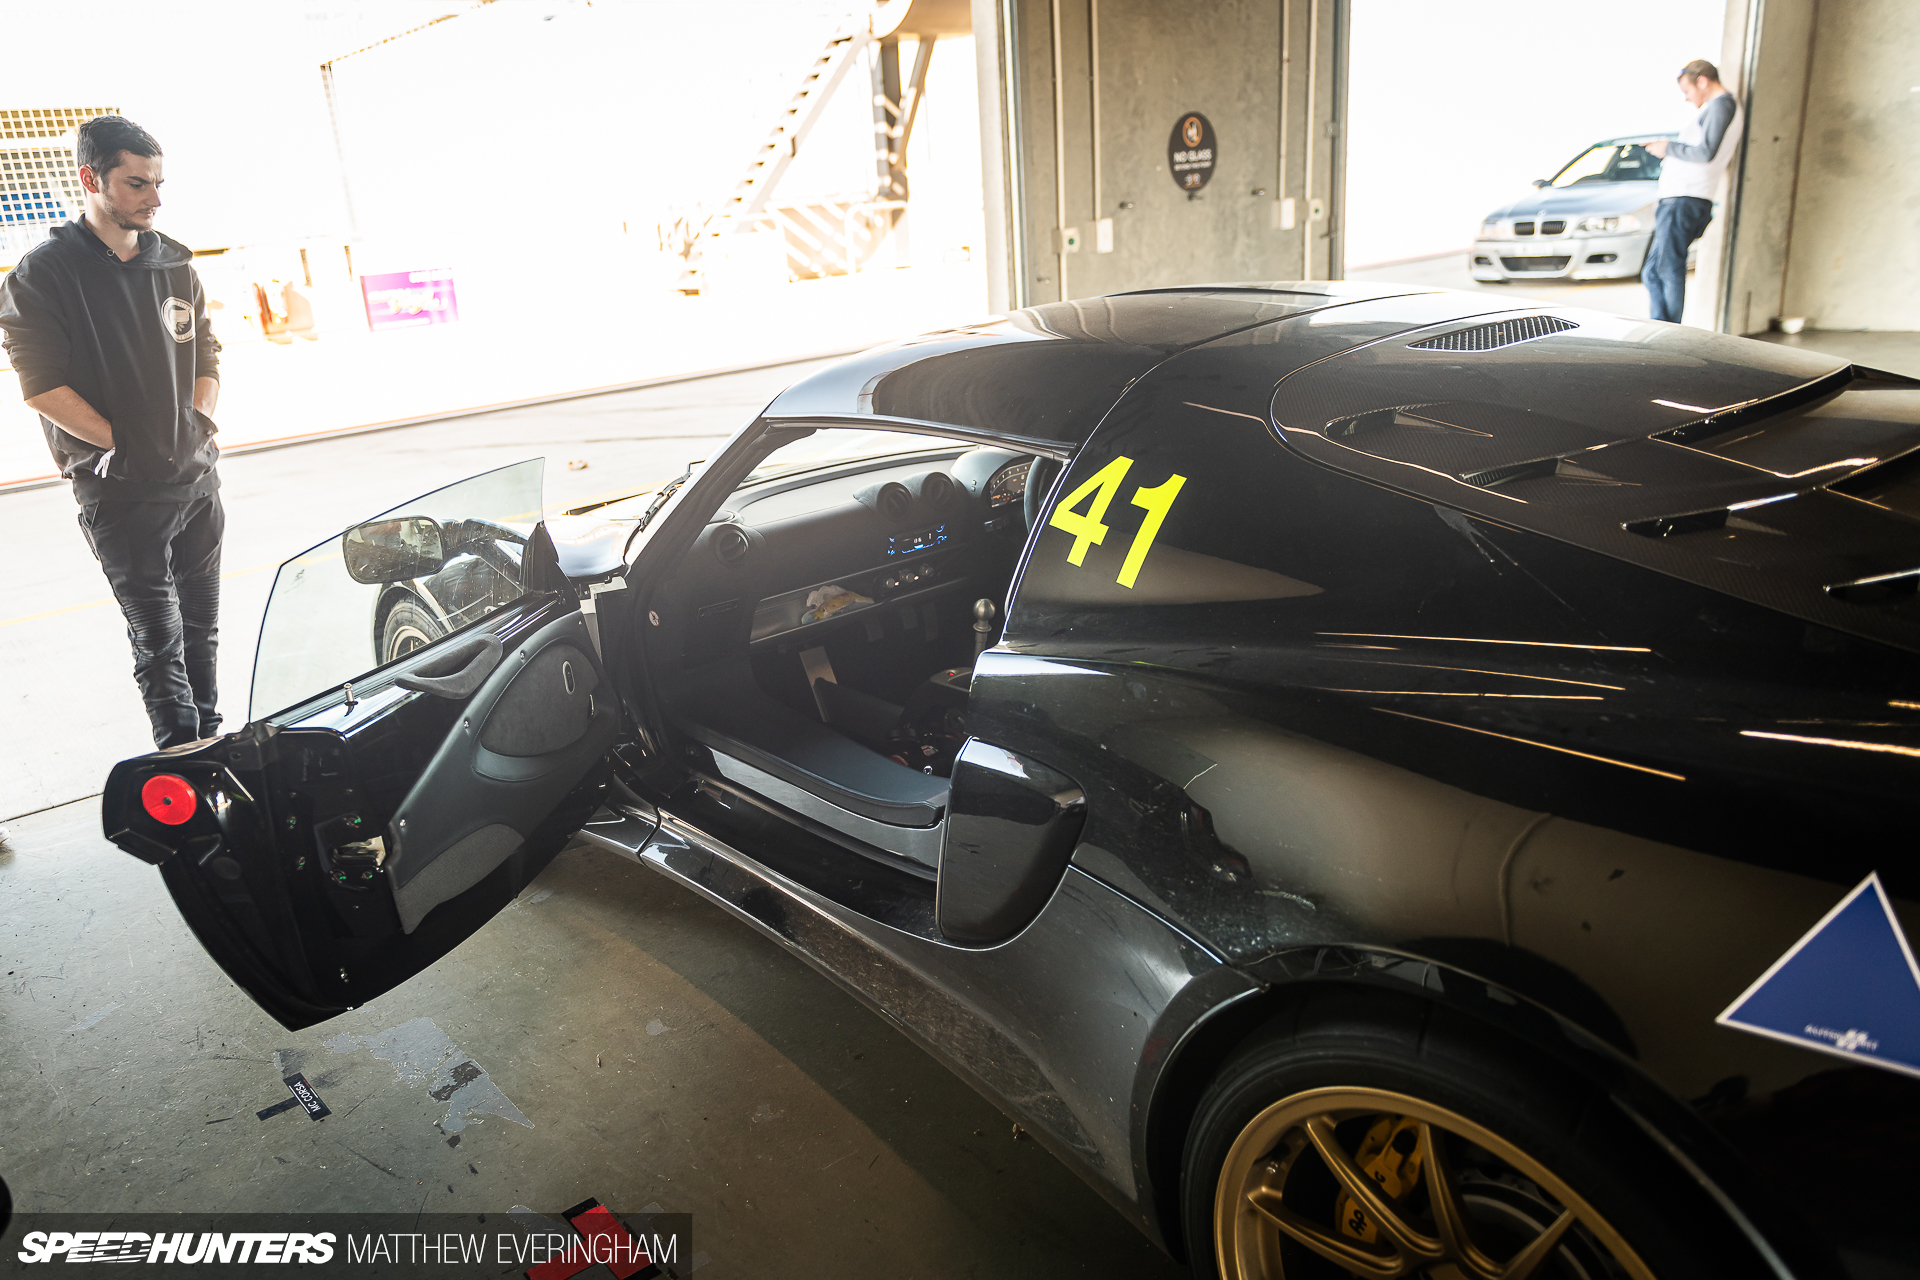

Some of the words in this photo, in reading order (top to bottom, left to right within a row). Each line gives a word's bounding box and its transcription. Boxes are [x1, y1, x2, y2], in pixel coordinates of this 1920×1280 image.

[1173, 151, 1187, 163] NO
[1187, 149, 1212, 162] GLASS
[1049, 455, 1188, 590] 41
[294, 1081, 312, 1101] CORSA
[1348, 1209, 1368, 1237] AP
